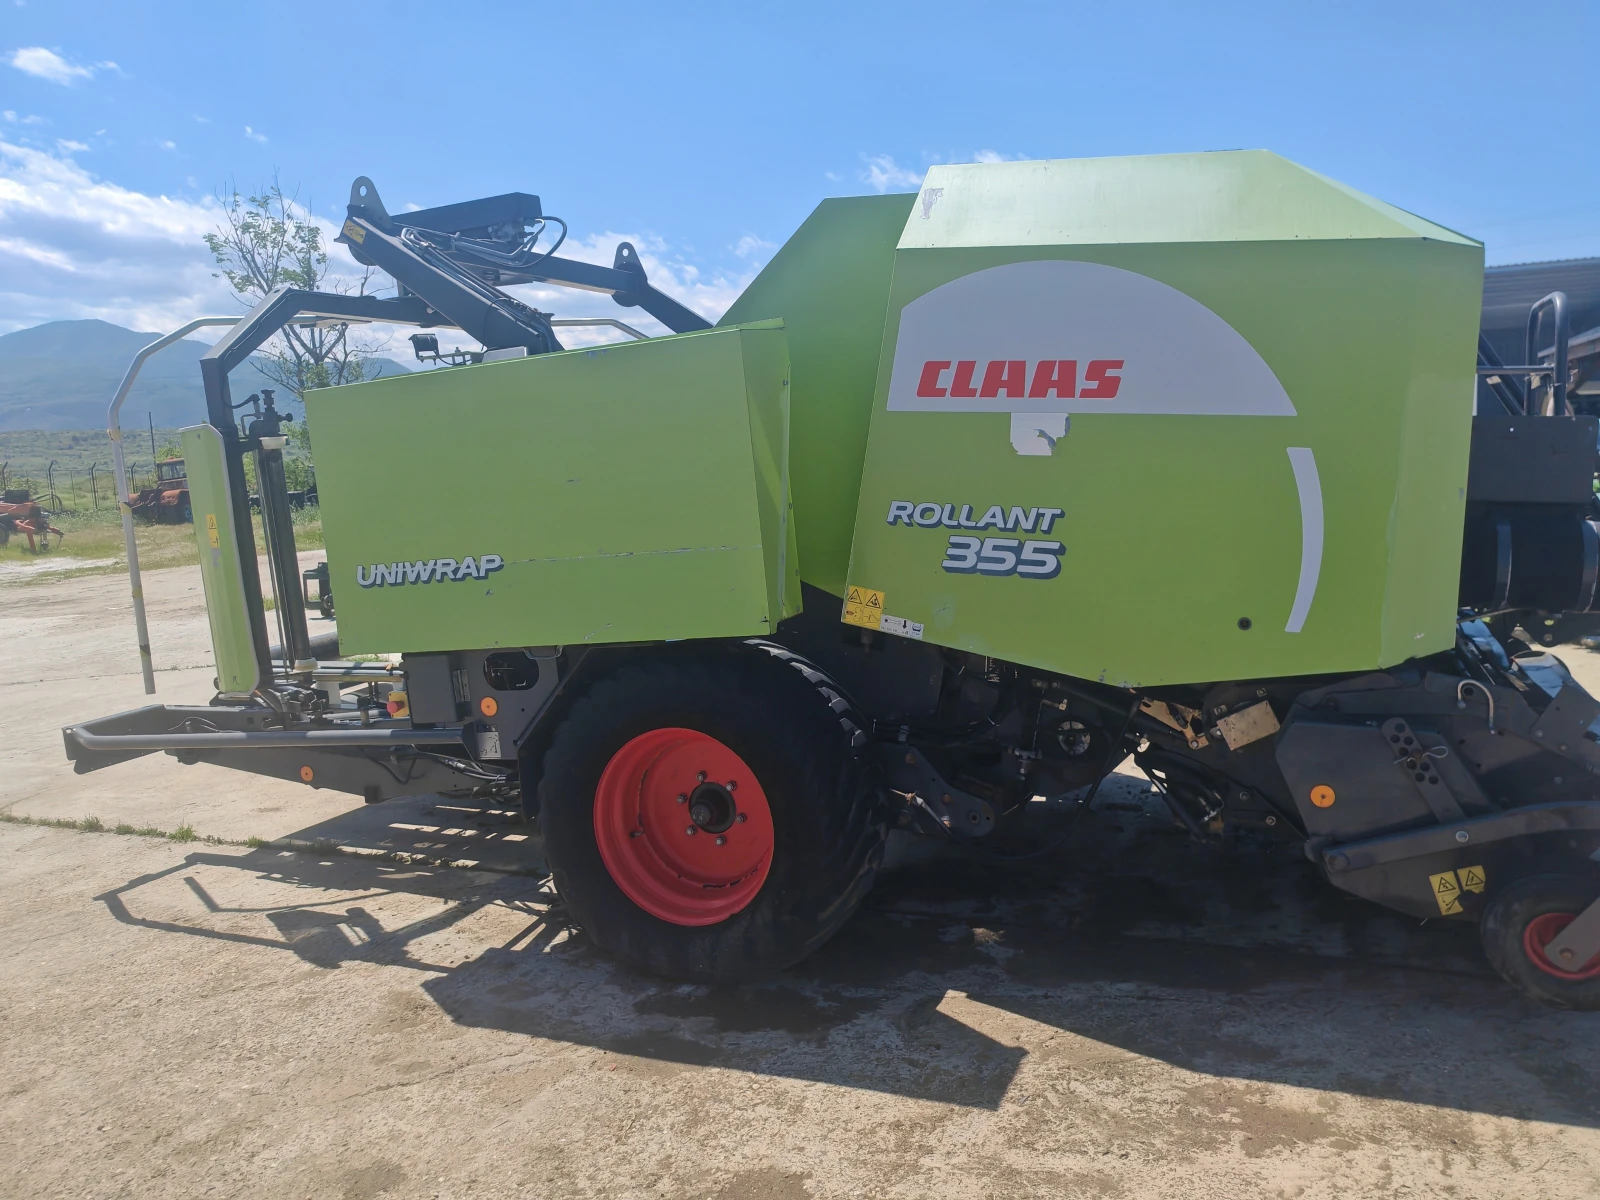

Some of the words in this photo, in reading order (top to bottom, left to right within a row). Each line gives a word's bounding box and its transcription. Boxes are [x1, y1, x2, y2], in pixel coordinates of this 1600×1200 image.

[916, 360, 1124, 398] CLAAS
[886, 500, 1065, 534] ROLLANT
[357, 554, 504, 588] UNIWRAP
[941, 535, 1066, 579] 355
